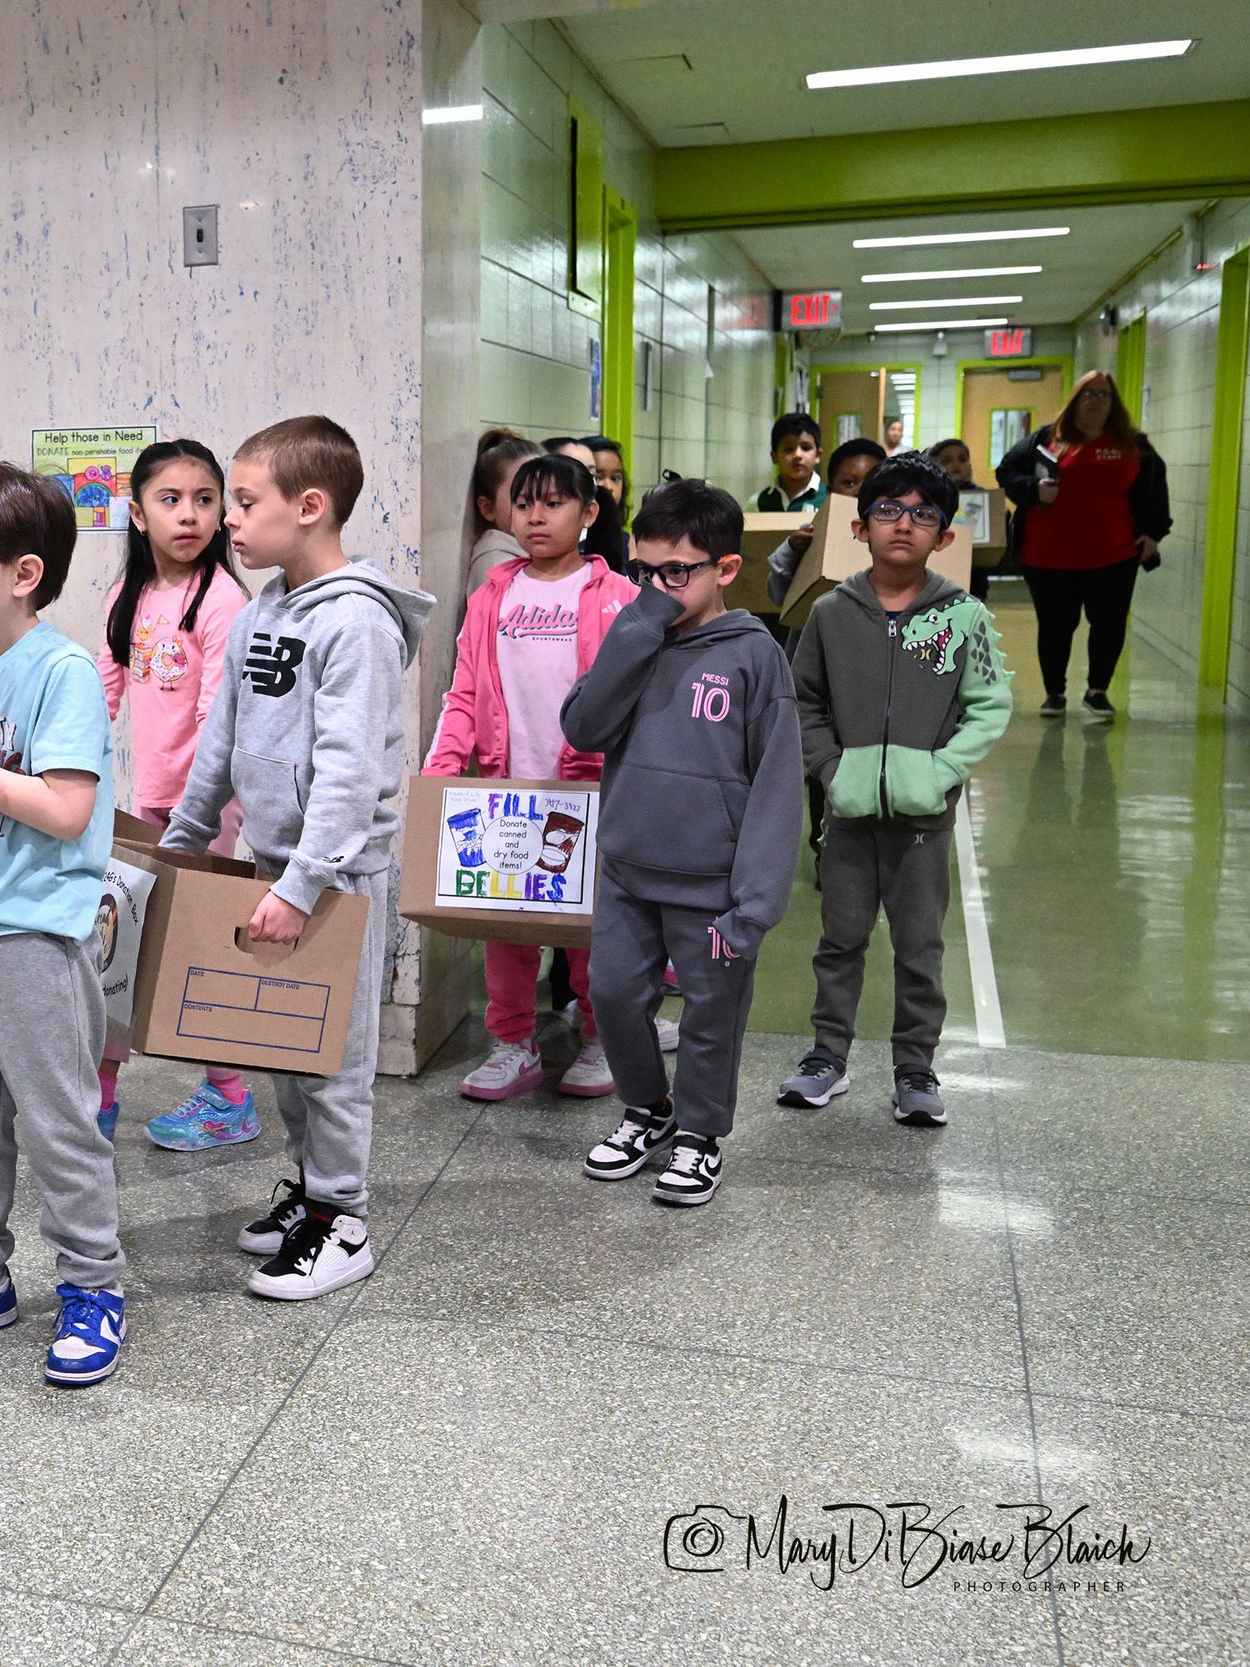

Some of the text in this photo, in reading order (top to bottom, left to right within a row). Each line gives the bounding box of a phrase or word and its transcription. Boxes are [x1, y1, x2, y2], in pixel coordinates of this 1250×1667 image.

[790, 295, 831, 326] EXIT
[990, 330, 1023, 355] EXIT
[44, 430, 143, 446] Help those in Need
[37, 447, 69, 456] DONATE
[119, 447, 134, 455] food
[498, 603, 579, 639] Adida
[701, 672, 729, 687] MESSI
[690, 682, 731, 722] 10
[487, 792, 543, 821] FILL
[499, 819, 528, 828] Donate
[499, 830, 527, 839] canned
[505, 840, 520, 848] and
[493, 850, 529, 861] dry food
[499, 861, 523, 870] items!
[455, 869, 567, 902] BELLIES
[116, 875, 133, 906] Donation
[130, 903, 139, 926] Box
[190, 970, 205, 978] DATE
[102, 974, 129, 996] donating!
[260, 979, 300, 991] DESTROY DATE
[183, 1003, 213, 1013] CONTENTS
